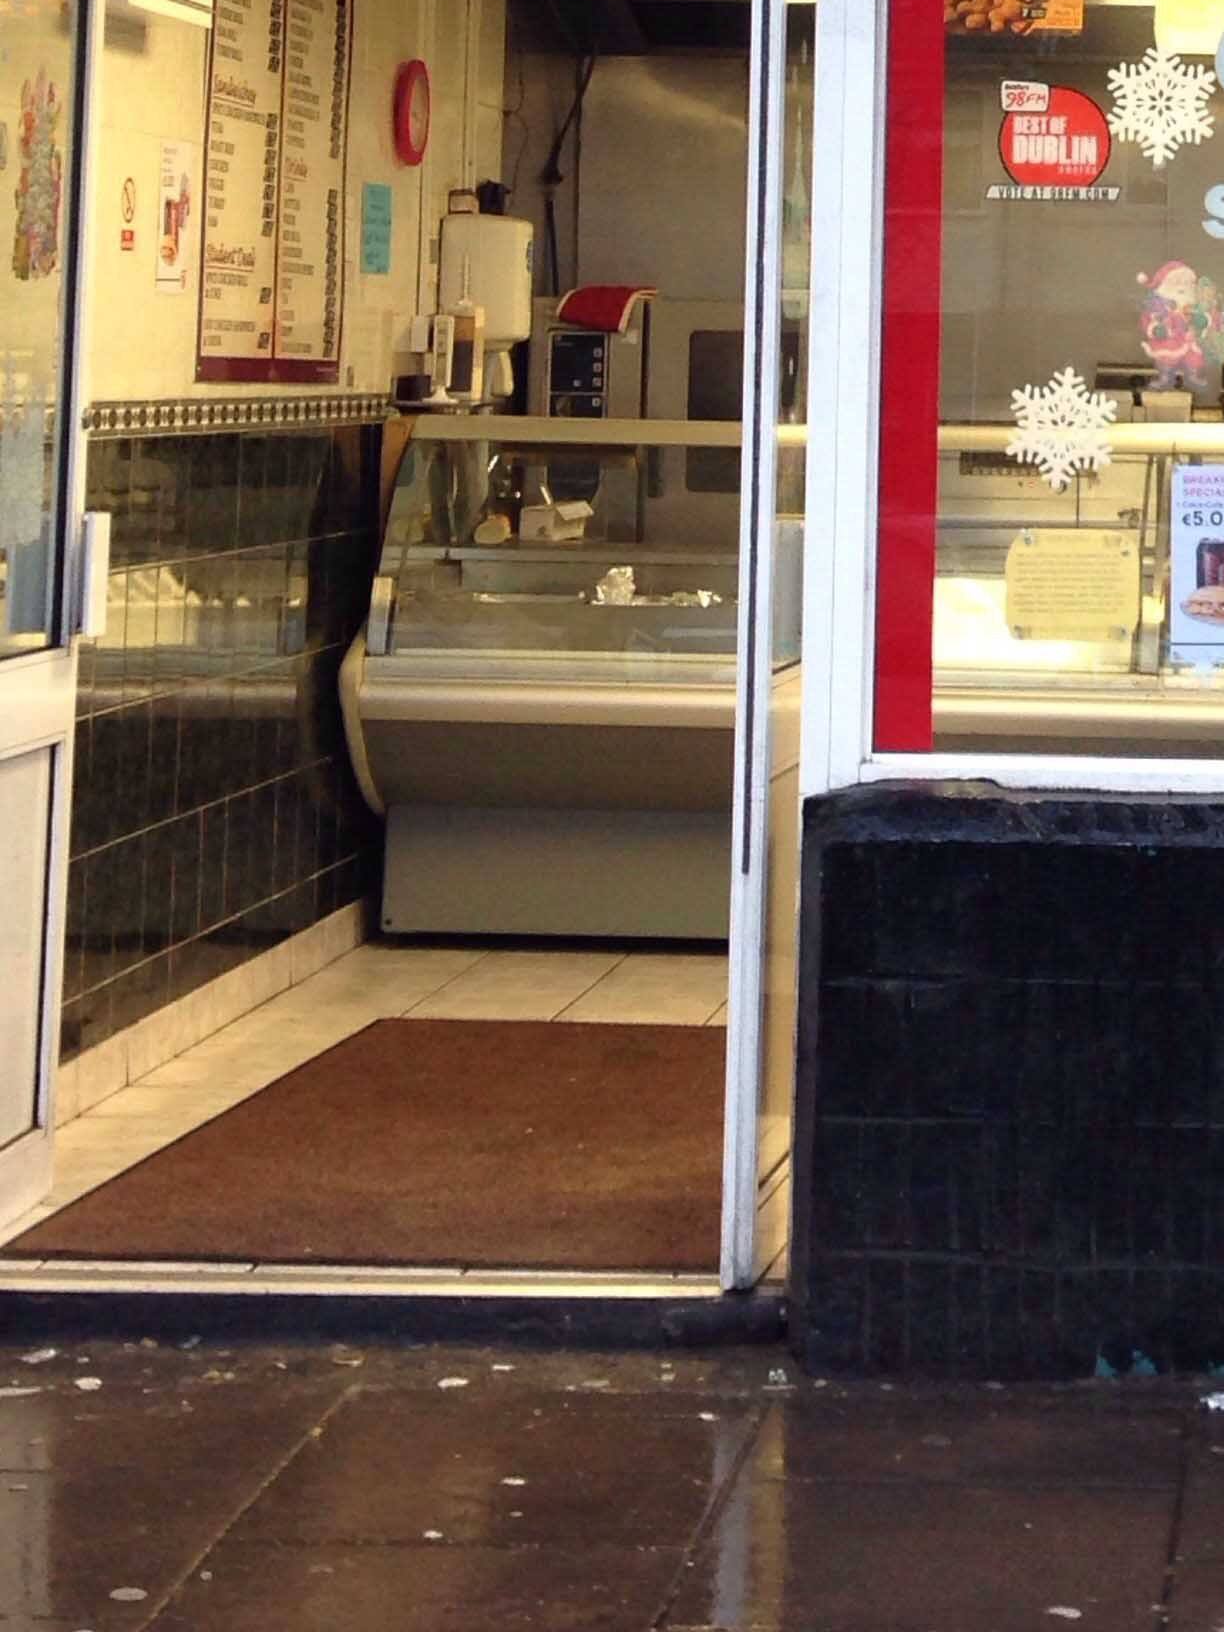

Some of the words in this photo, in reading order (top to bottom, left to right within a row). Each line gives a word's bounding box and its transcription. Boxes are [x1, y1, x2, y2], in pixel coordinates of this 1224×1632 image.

[1006, 92, 1046, 108] 98FM
[1013, 115, 1047, 135] BEST
[1012, 135, 1098, 165] DUBLIN
